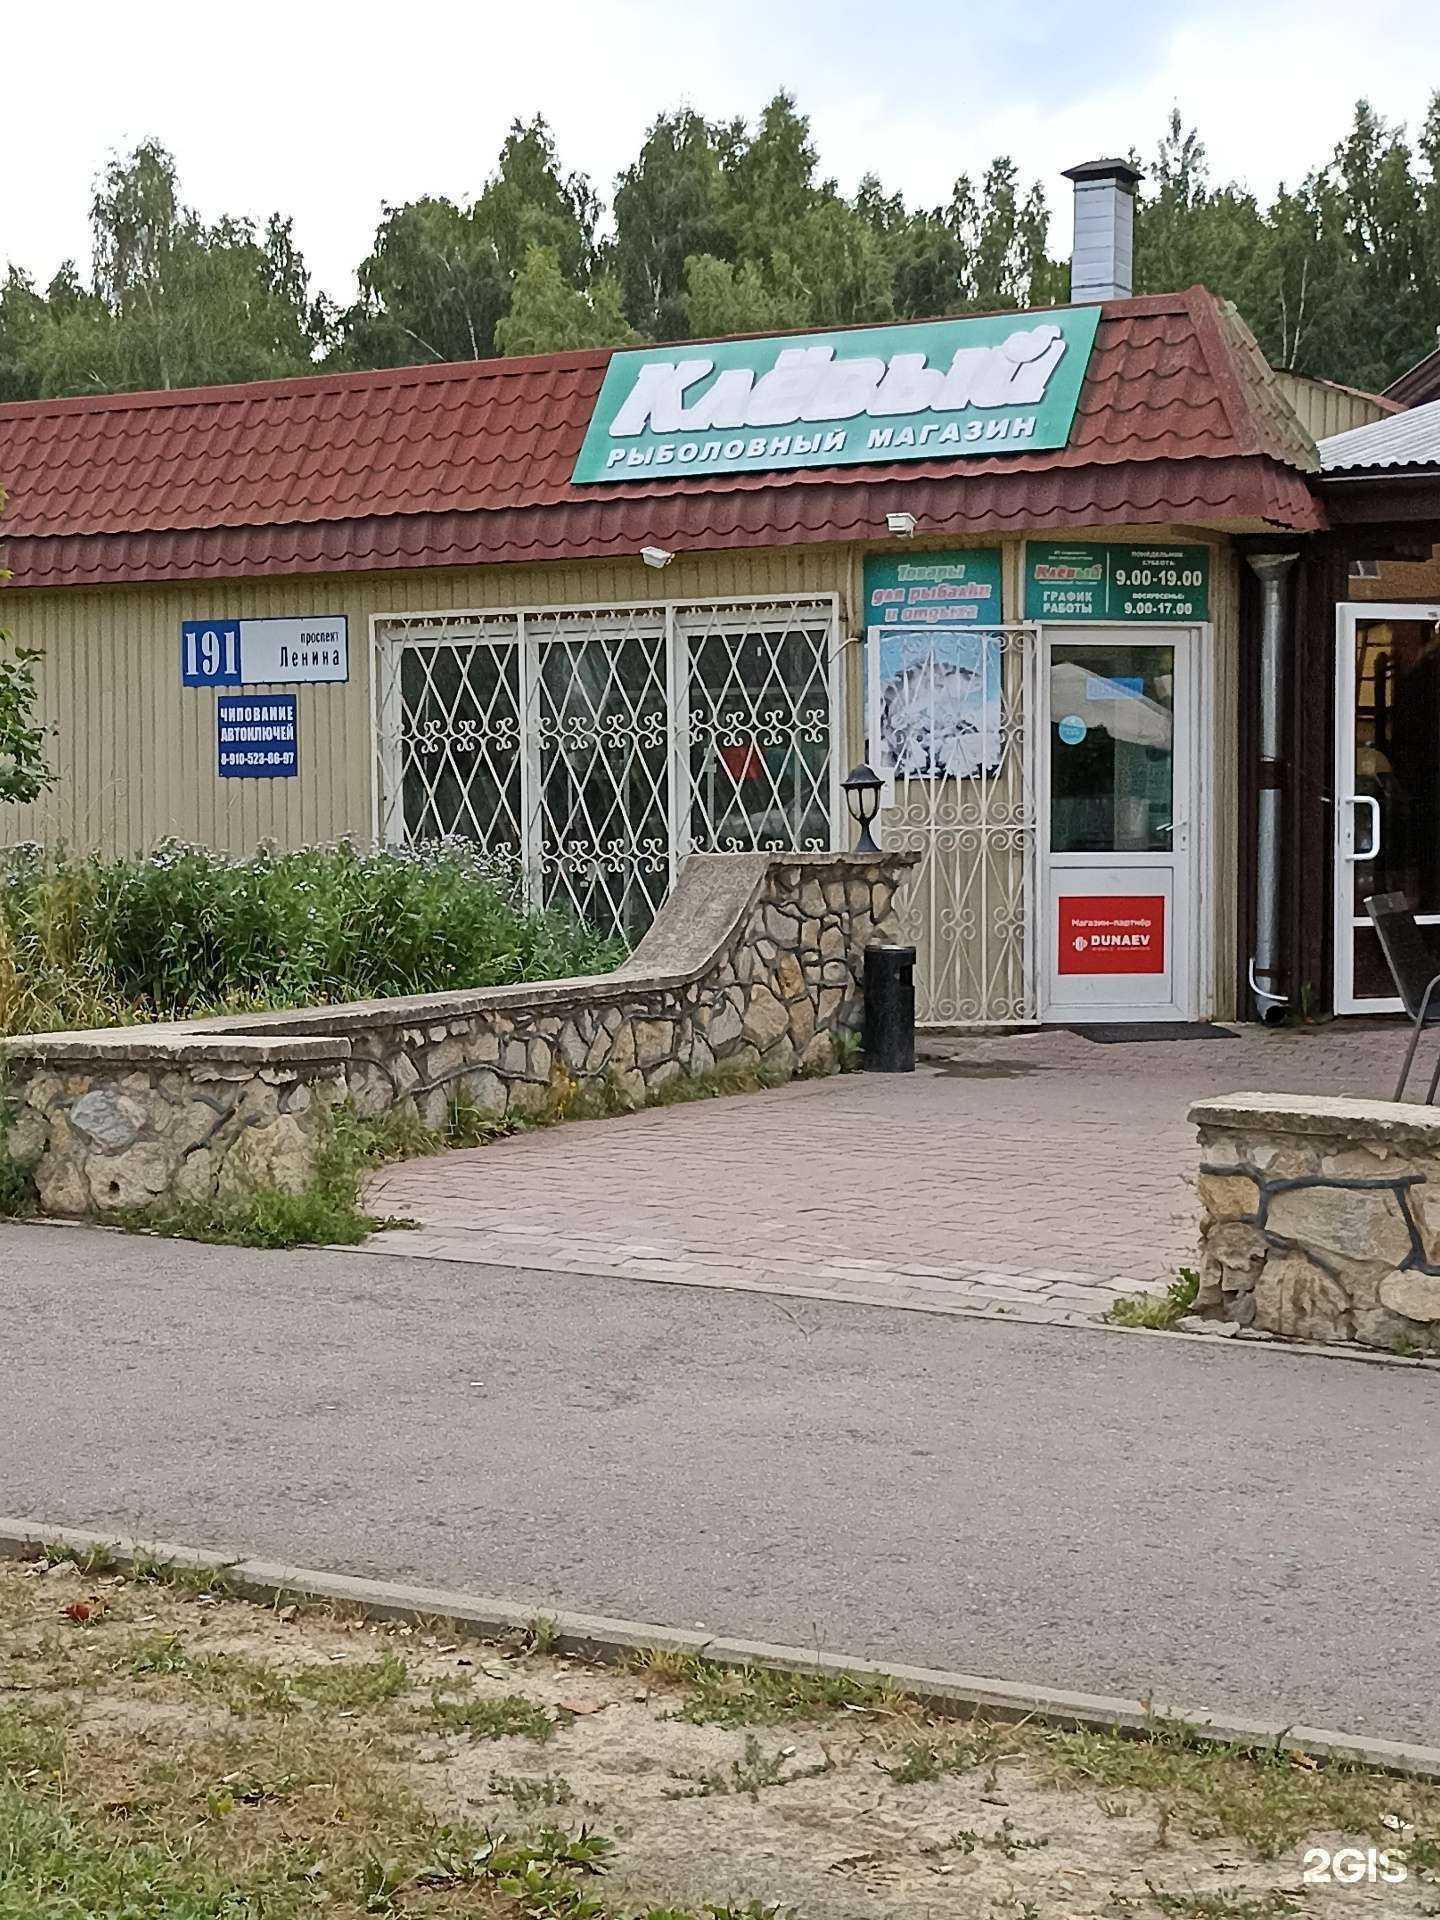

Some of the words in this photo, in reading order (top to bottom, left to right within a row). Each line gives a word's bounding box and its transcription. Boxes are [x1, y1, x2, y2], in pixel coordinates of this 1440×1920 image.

[608, 325, 1066, 437] Клёвый
[606, 428, 846, 468] РЫБОЛОВНЫЙ
[866, 416, 1037, 449] МАГАЗИН
[897, 564, 966, 583] Товары
[1115, 570, 1202, 587] 9.00-19.00
[871, 588, 905, 607] для
[1043, 591, 1092, 602] ГРАФИК
[885, 608, 898, 622] и
[901, 605, 978, 623] отдыха
[1043, 602, 1092, 614] РАБОТЫ
[1124, 602, 1193, 615] 9.00-17.00
[300, 631, 339, 646] проспект
[185, 631, 238, 676] 191
[280, 646, 340, 667] Ленина
[220, 706, 294, 722] ЧИПОВАНИЕ
[220, 723, 294, 742] АВТОКЛЮЧЕЙ
[1091, 935, 1151, 946] DUNAEV
